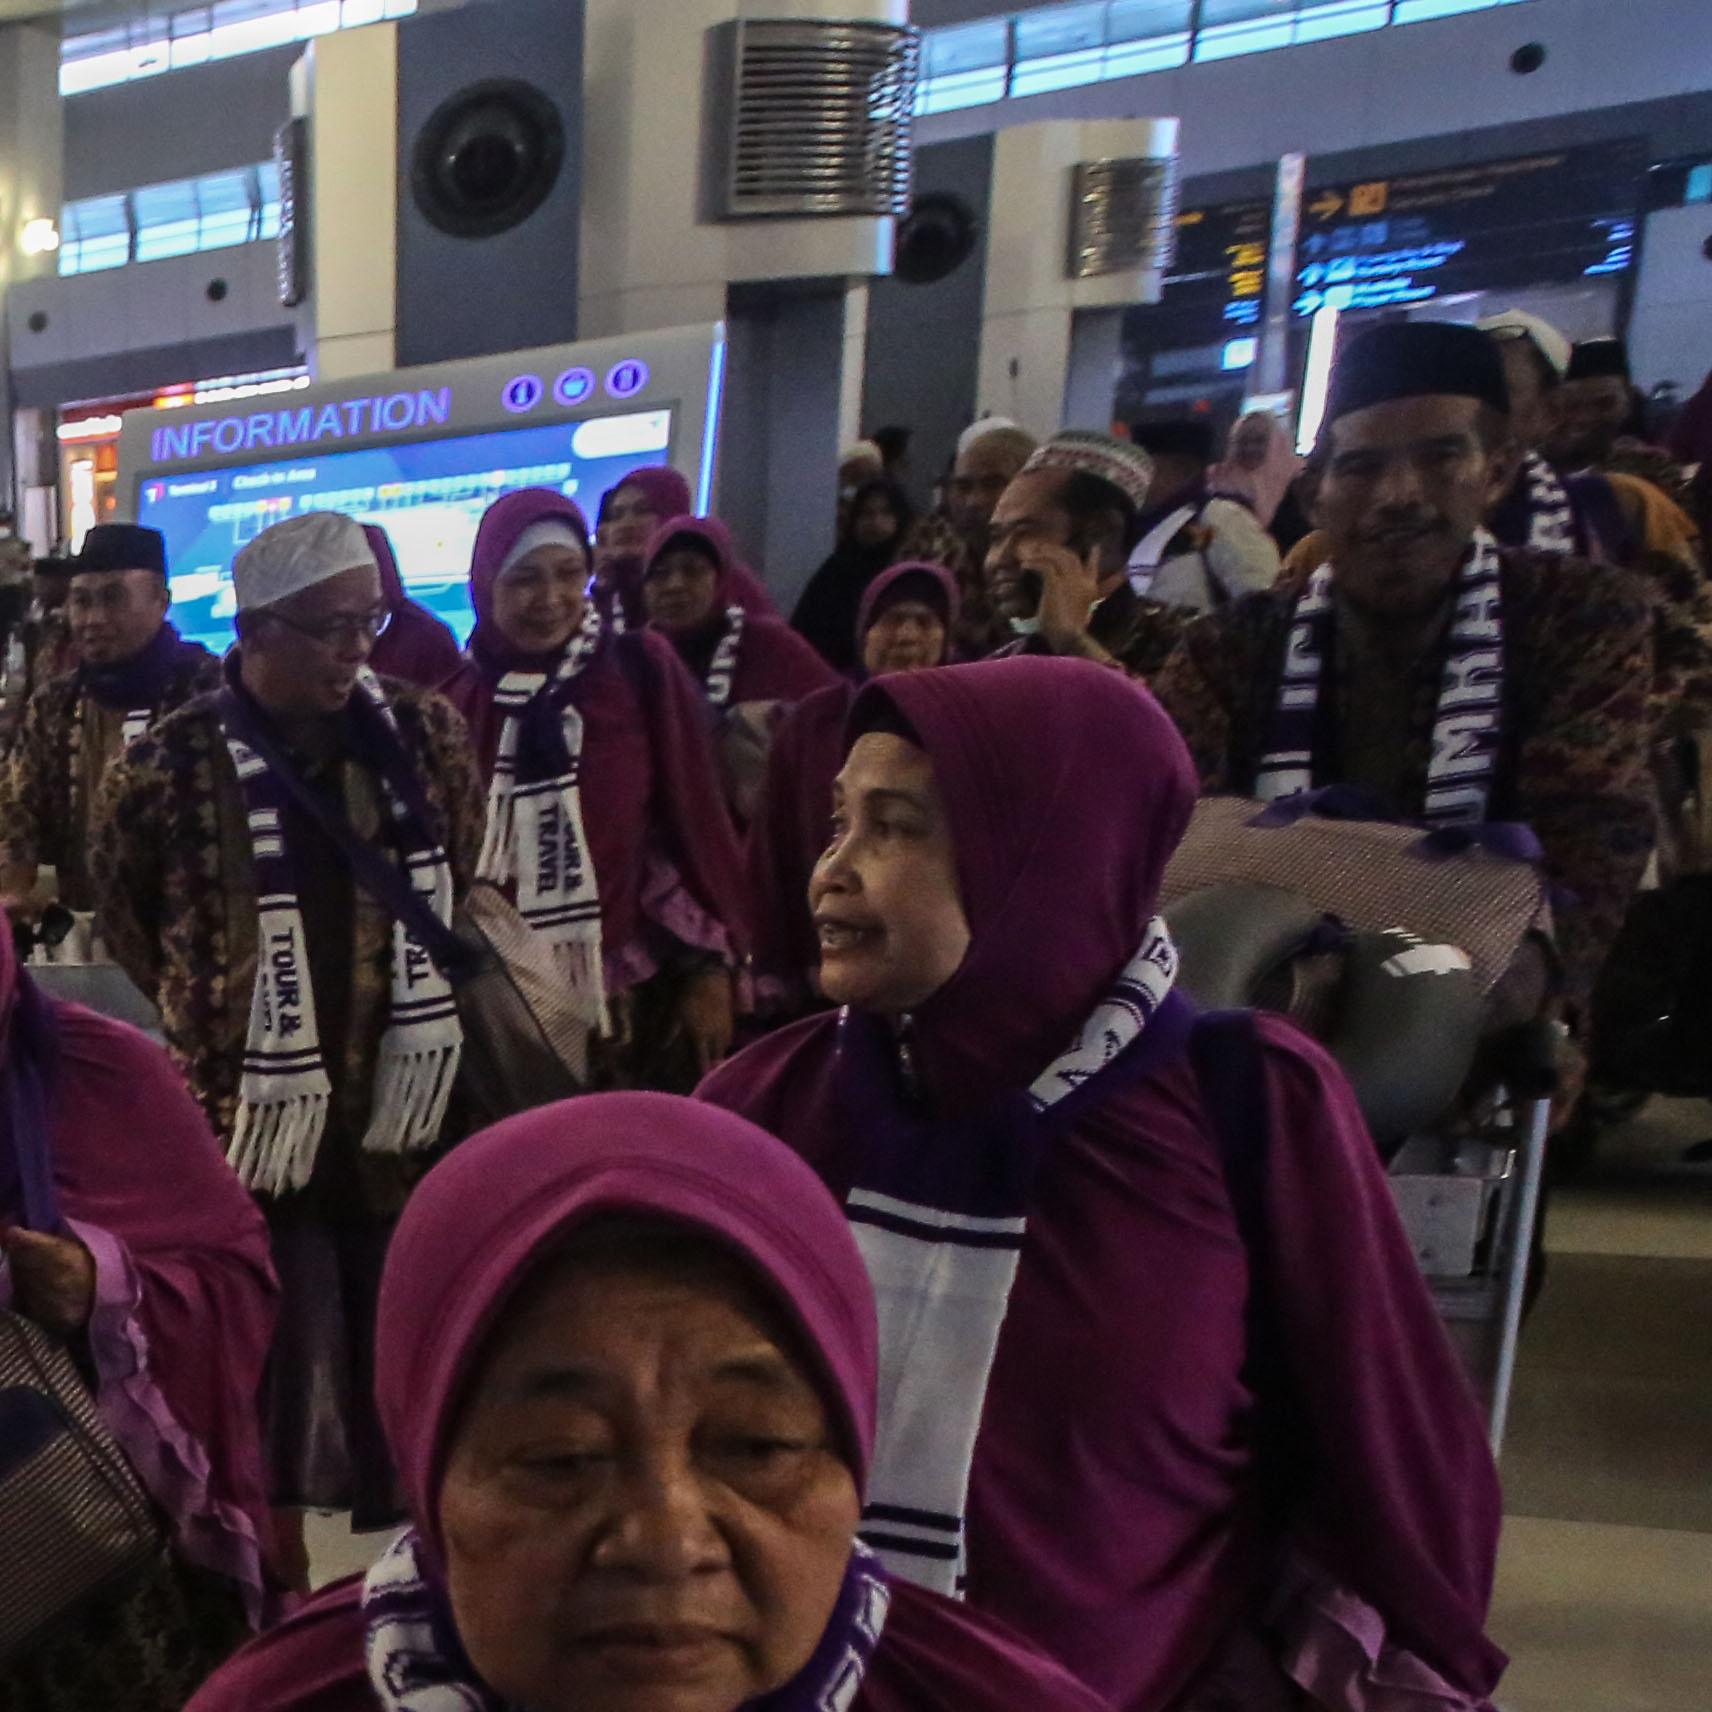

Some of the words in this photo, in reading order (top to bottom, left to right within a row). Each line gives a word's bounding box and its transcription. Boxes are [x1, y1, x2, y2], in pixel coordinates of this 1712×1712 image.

[151, 386, 452, 462] INFORMATION
[535, 804, 559, 897] TRAVEL
[270, 926, 301, 1010] TOUR
